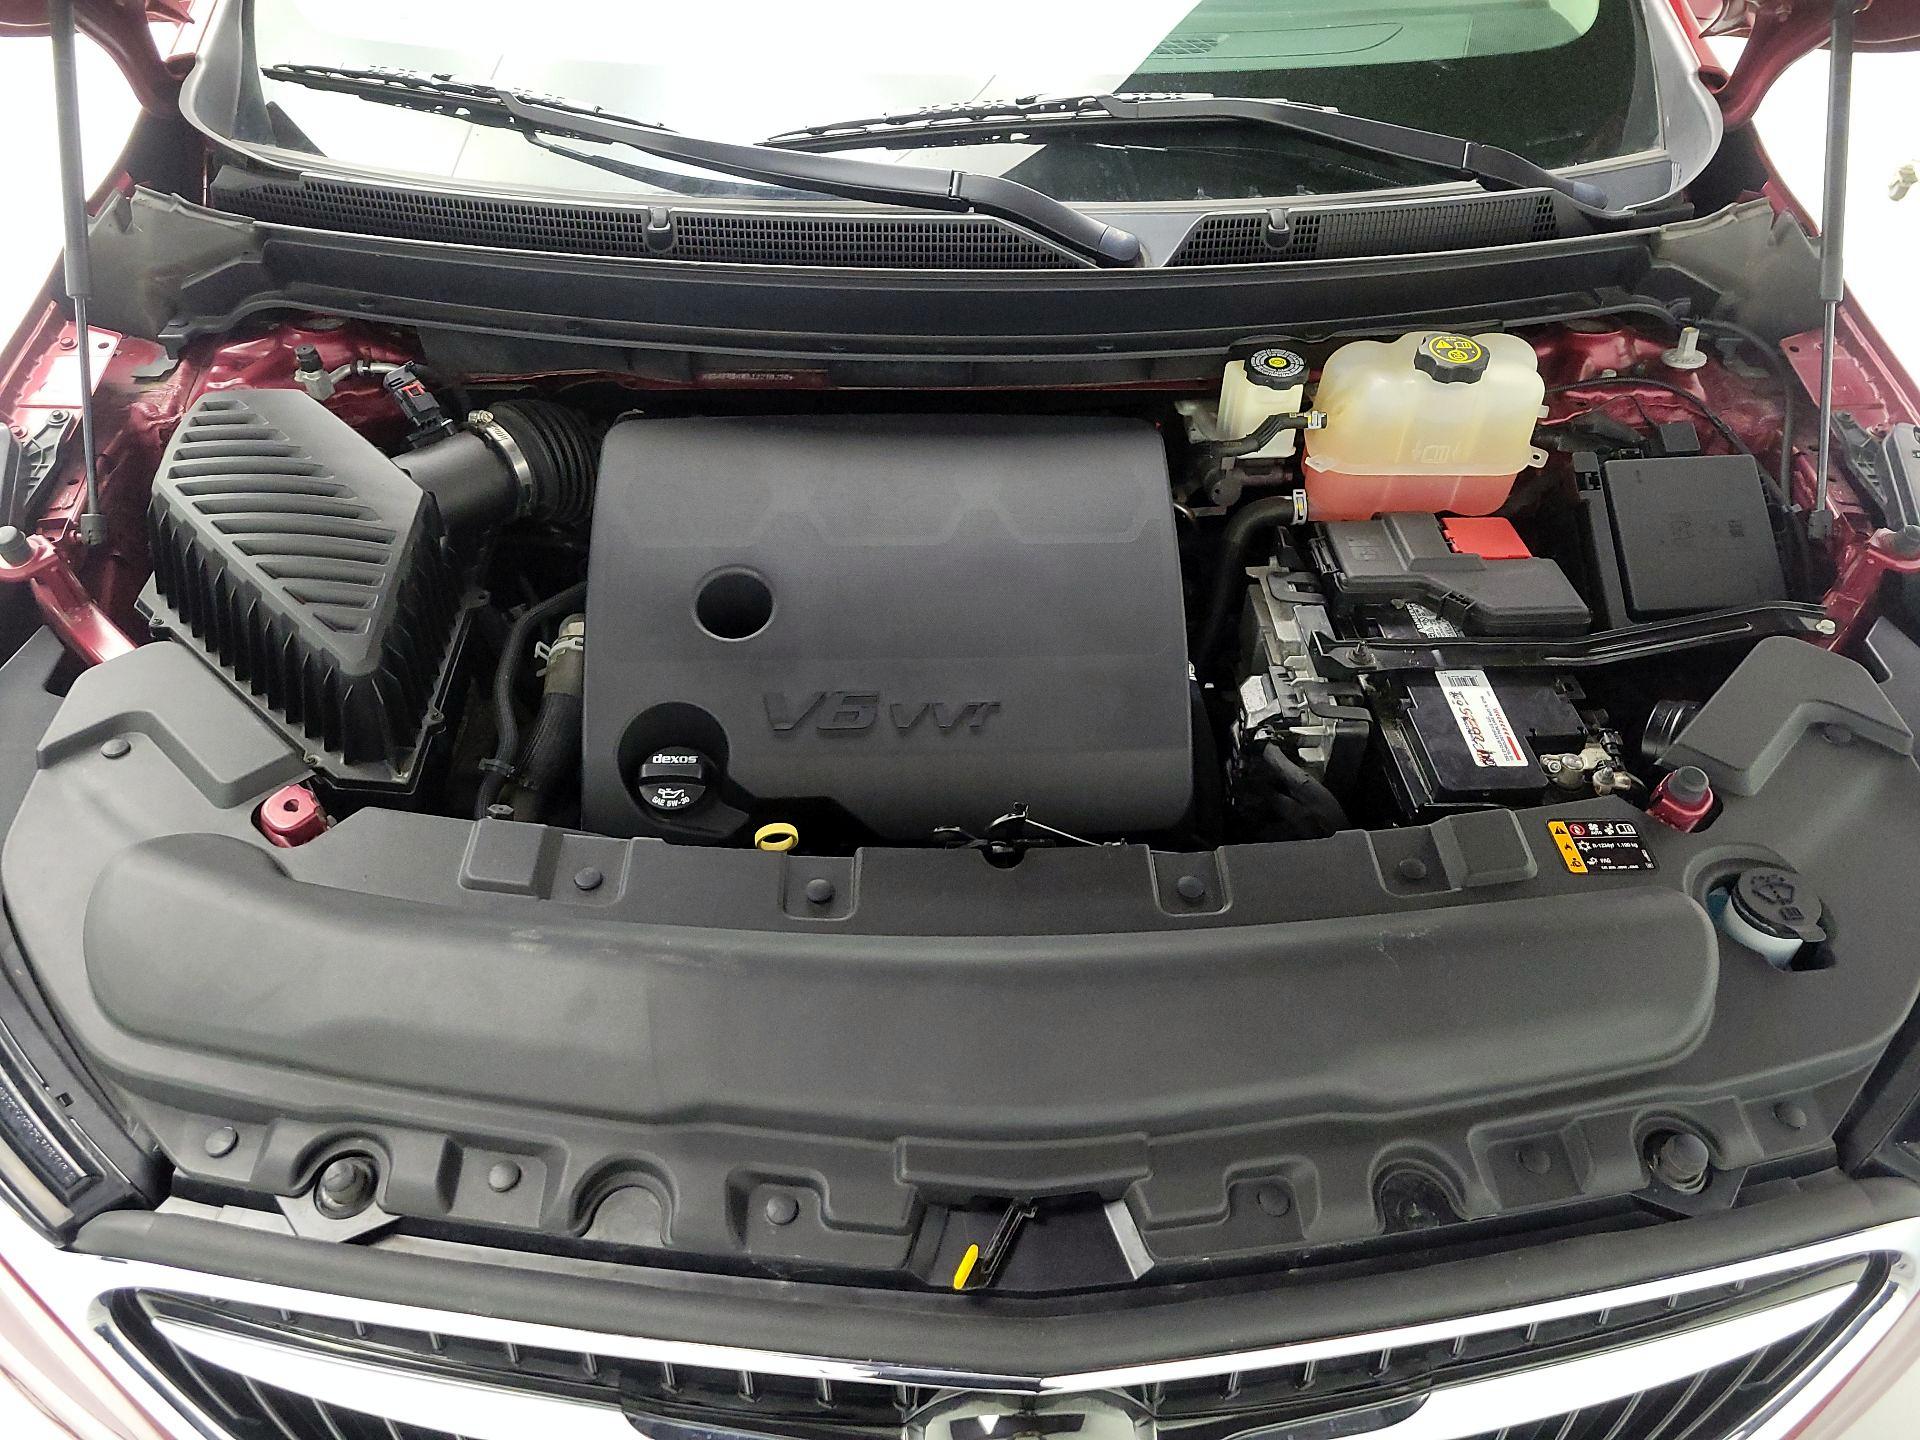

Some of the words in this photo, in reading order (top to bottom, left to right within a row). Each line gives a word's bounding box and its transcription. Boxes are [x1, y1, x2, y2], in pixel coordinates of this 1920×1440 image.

[763, 690, 879, 731] V6
[889, 701, 1000, 729] VVT
[652, 754, 699, 764] dexos
[652, 796, 666, 806] SAE
[667, 797, 690, 807] 5W-30
